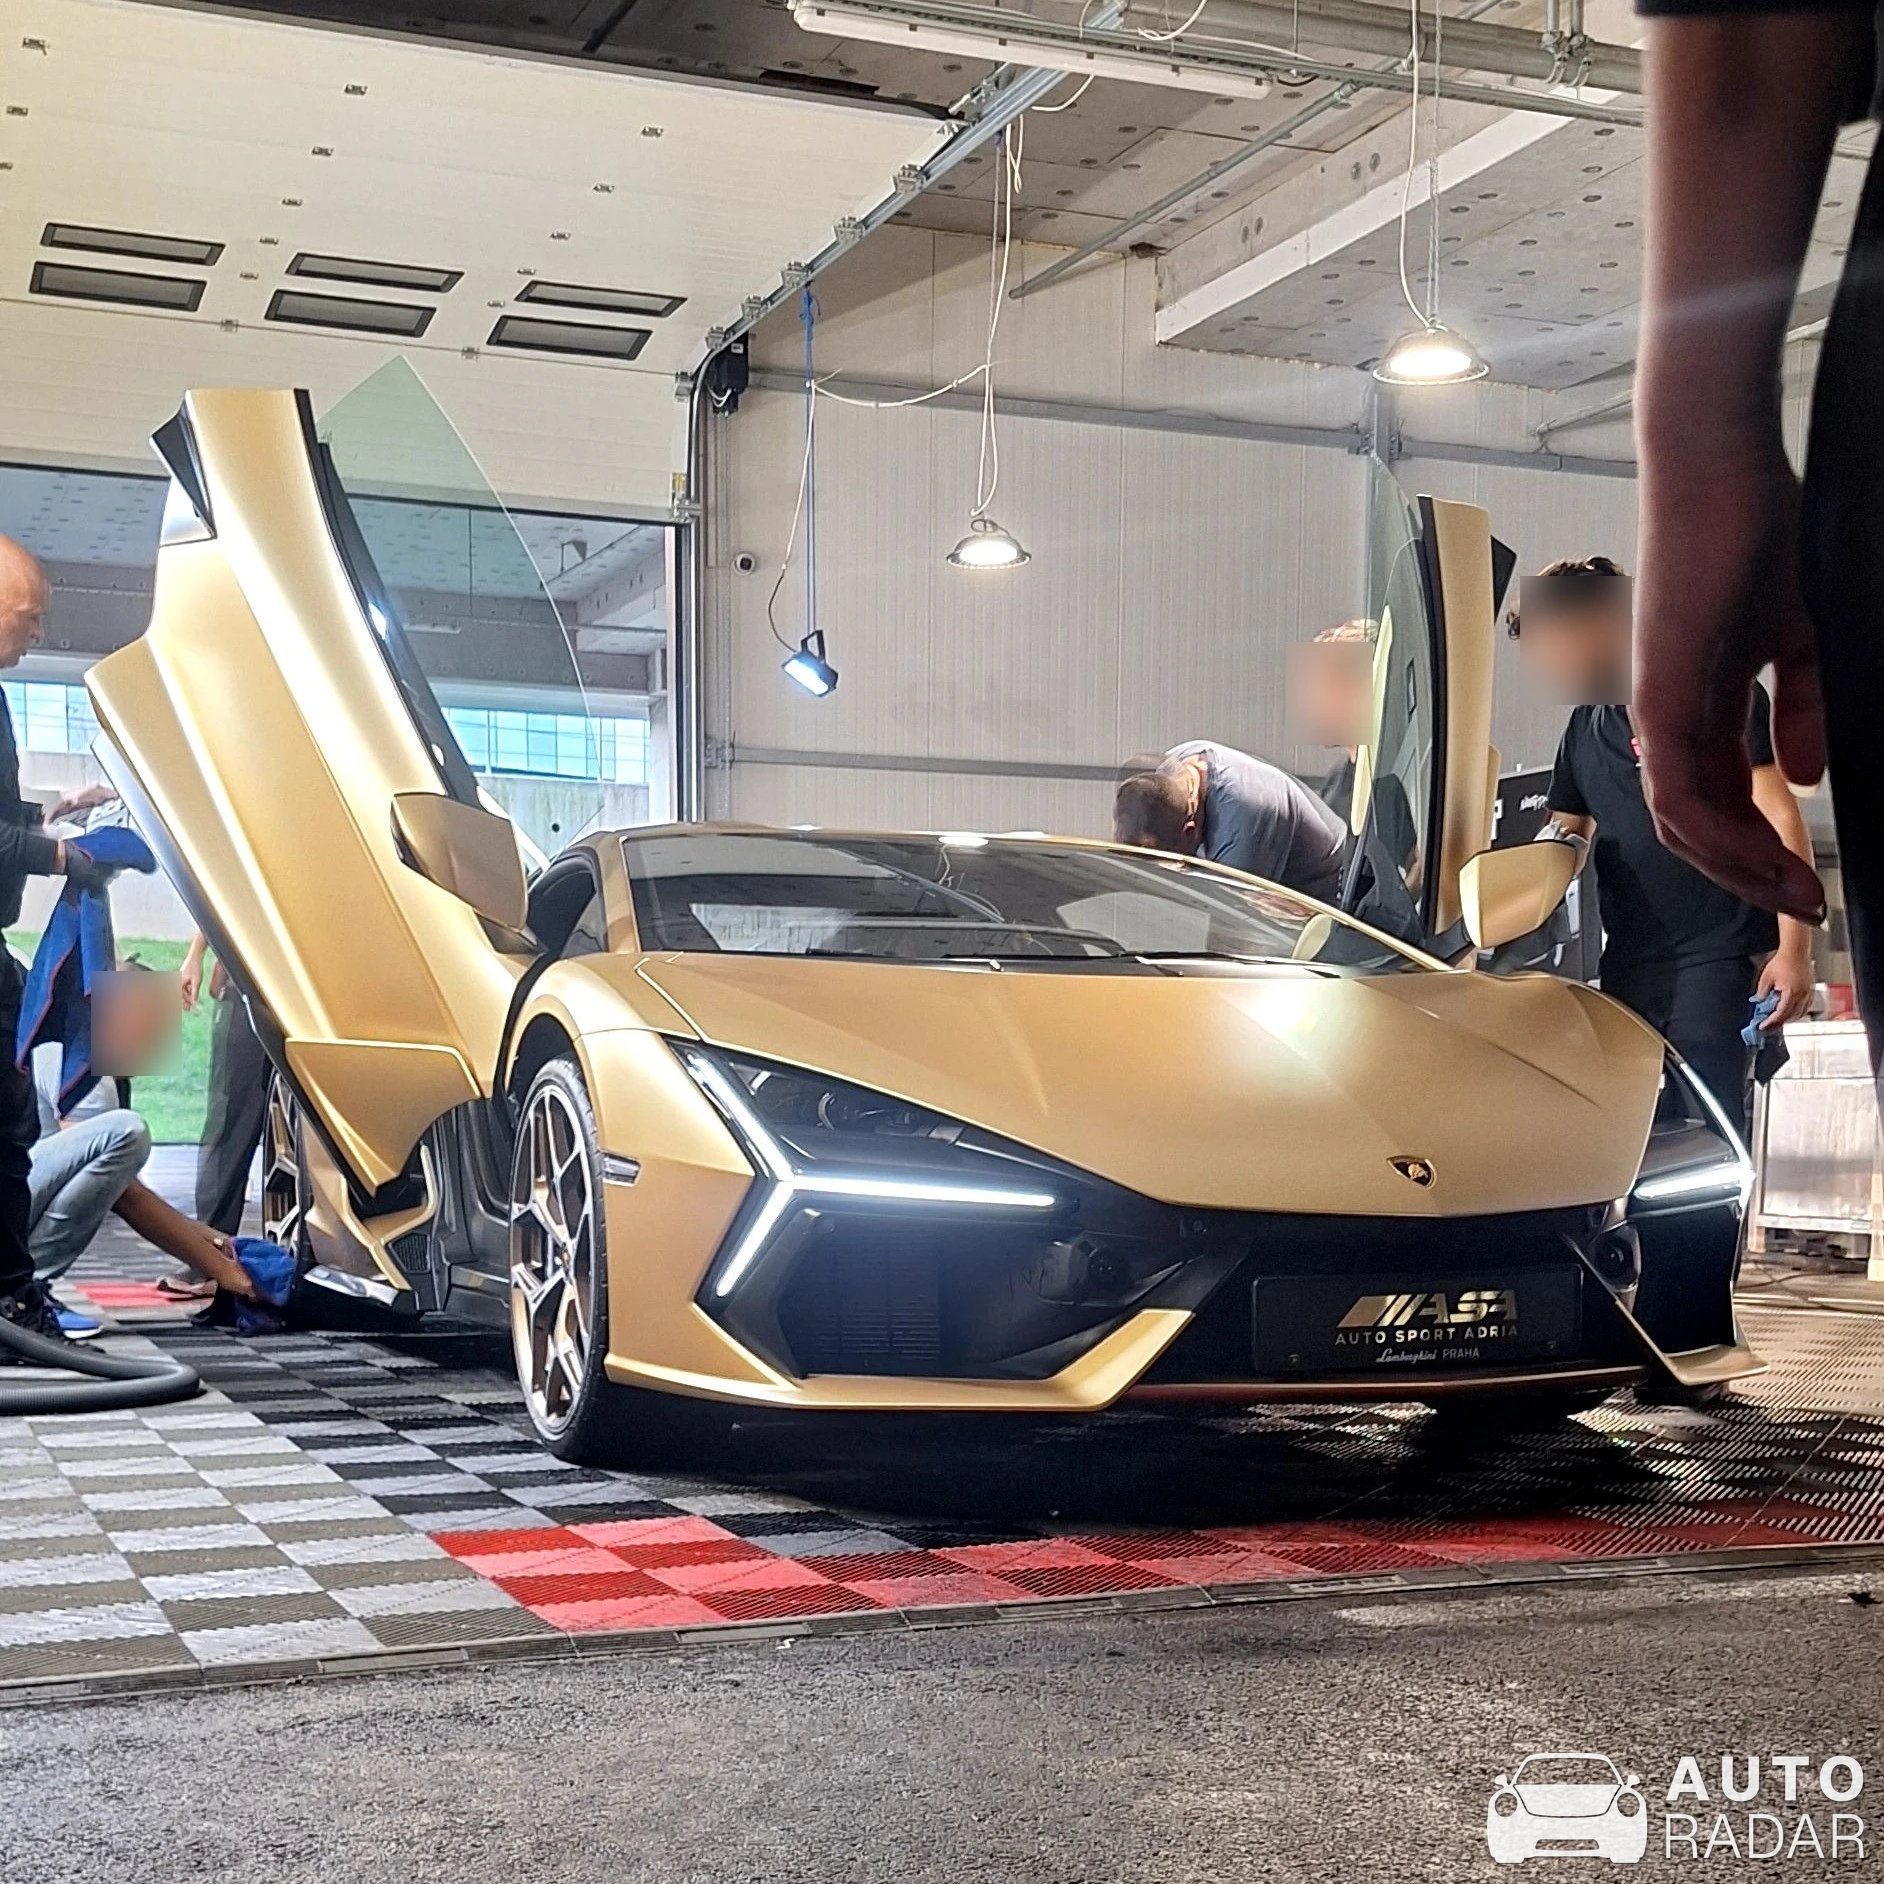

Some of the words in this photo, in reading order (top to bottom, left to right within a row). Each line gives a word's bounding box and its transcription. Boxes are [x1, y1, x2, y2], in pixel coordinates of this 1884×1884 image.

[1334, 1331, 1387, 1345] AUTO
[1395, 1327, 1456, 1343] SPORT
[1464, 1325, 1517, 1340] ADRIA
[1375, 1348, 1438, 1364] Lamborghini
[1442, 1347, 1480, 1359] PRAHA
